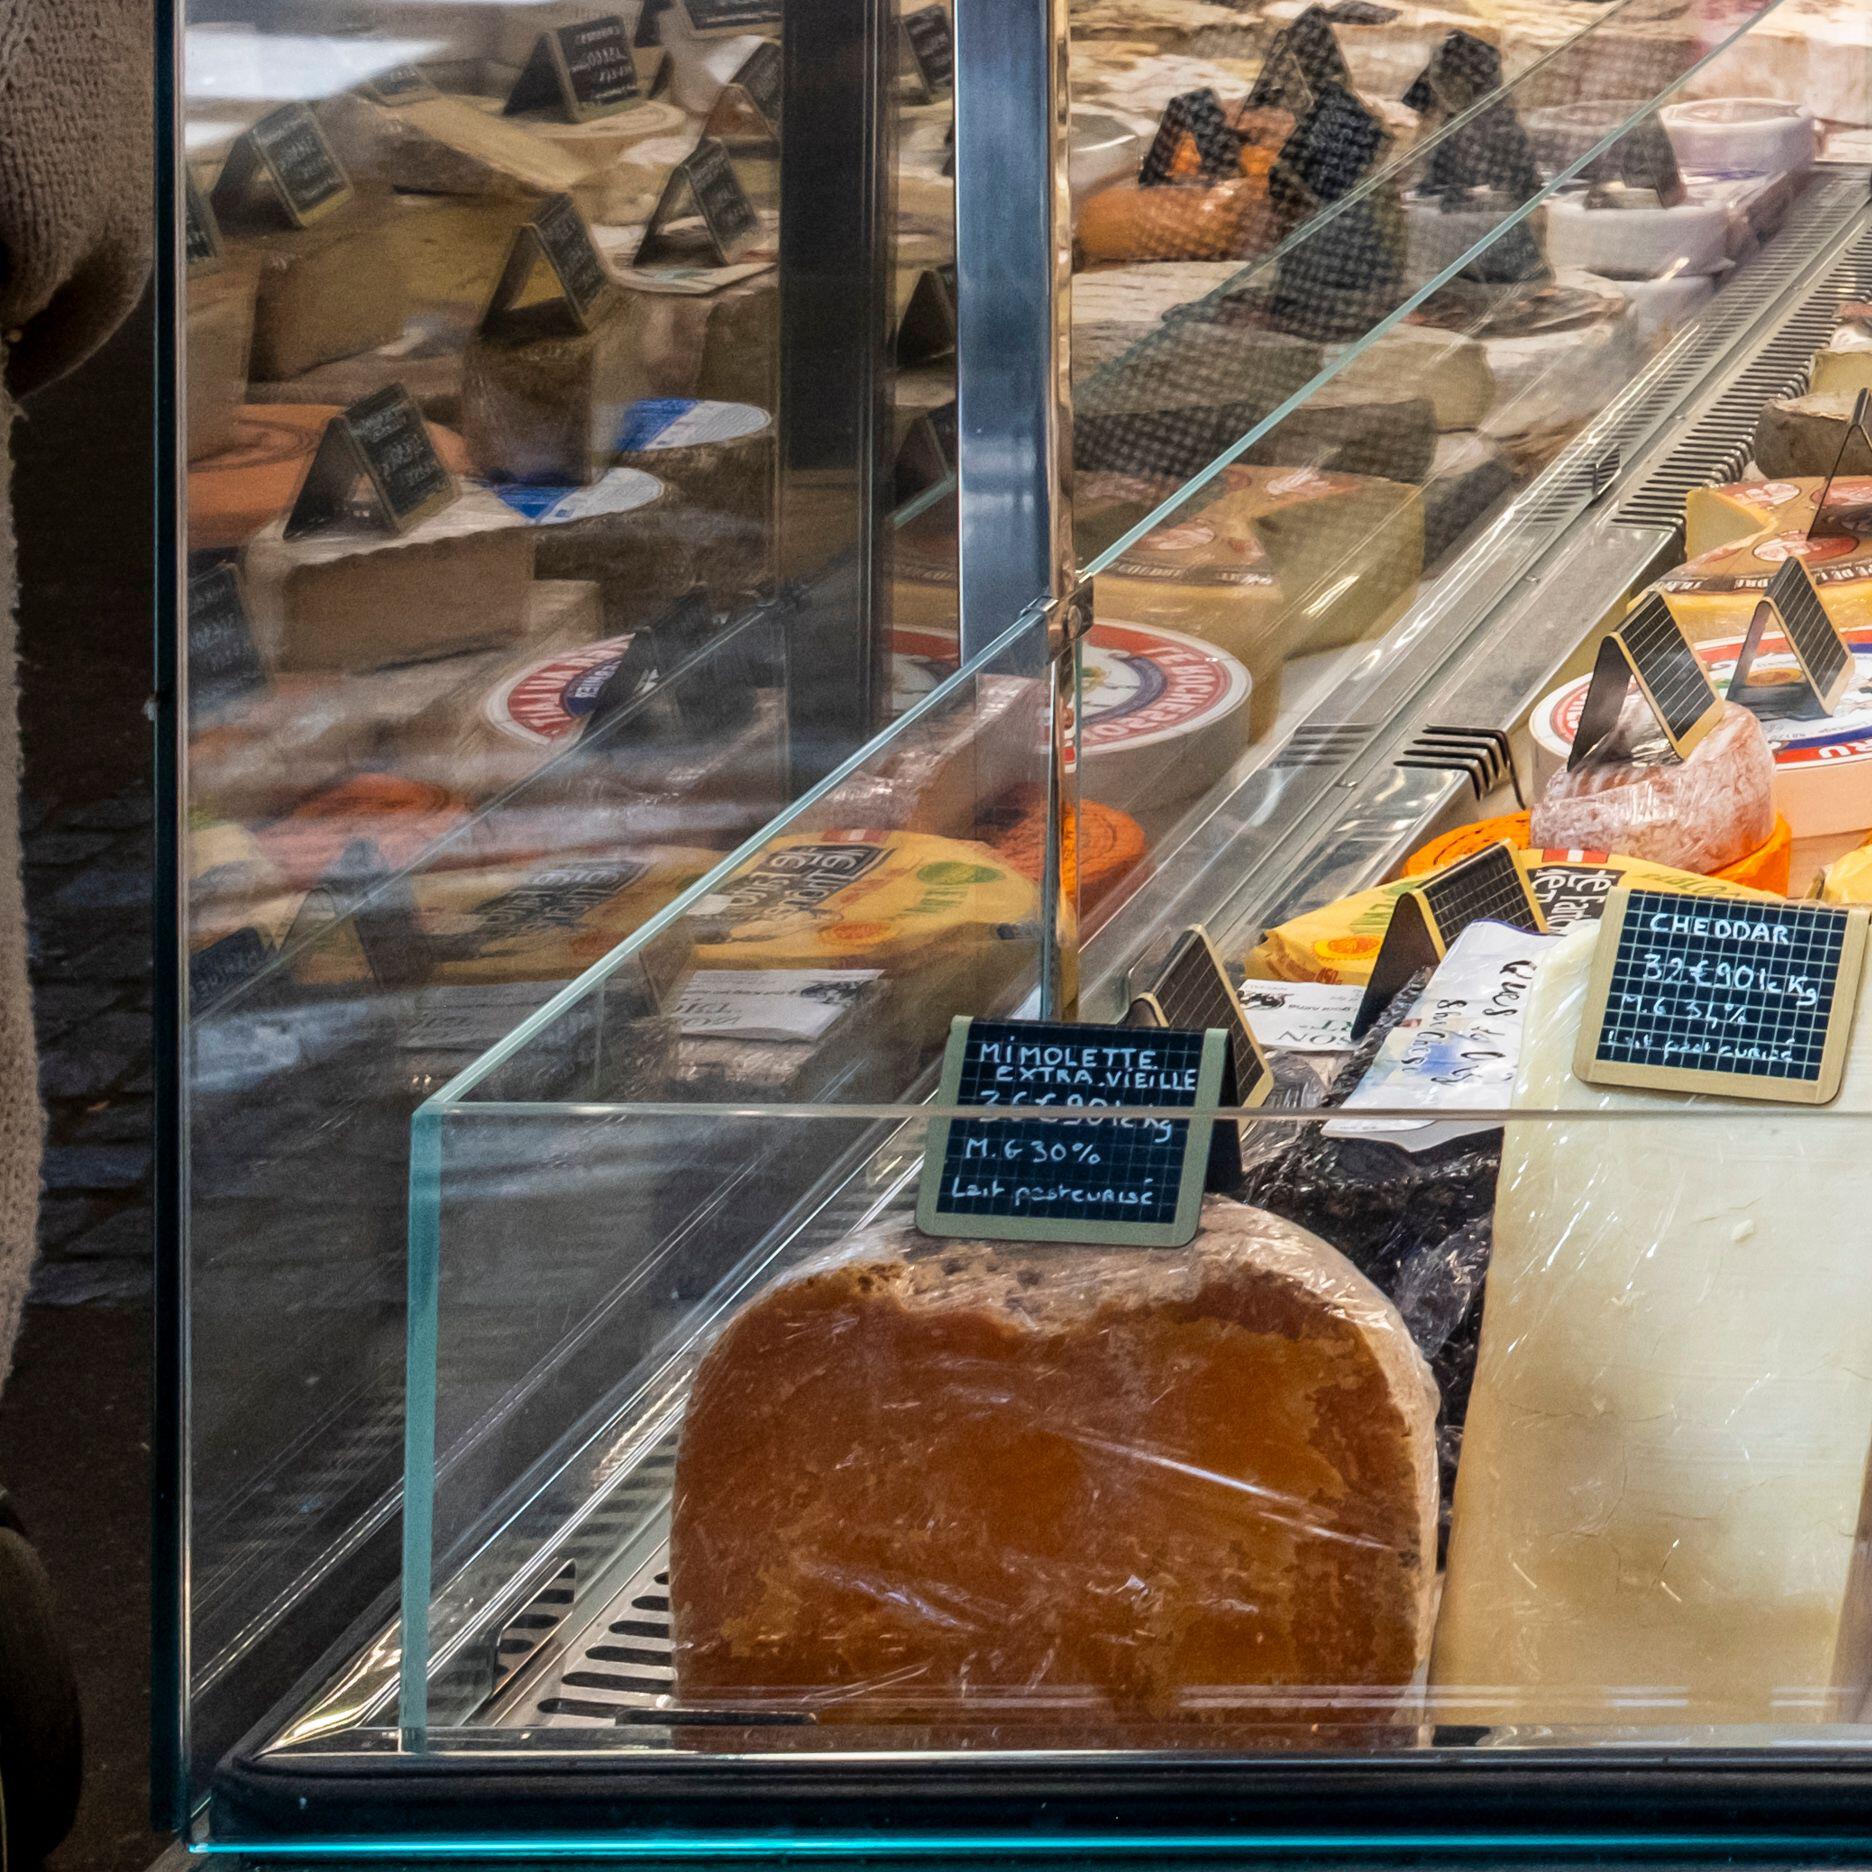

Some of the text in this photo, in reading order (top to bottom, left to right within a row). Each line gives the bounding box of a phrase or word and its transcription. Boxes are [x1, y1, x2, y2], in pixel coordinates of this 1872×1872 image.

[1650, 913, 1789, 944] CHEDDAR
[1643, 953, 1817, 1006] 32€90 Kg
[1033, 1142, 1101, 1165] 30%
